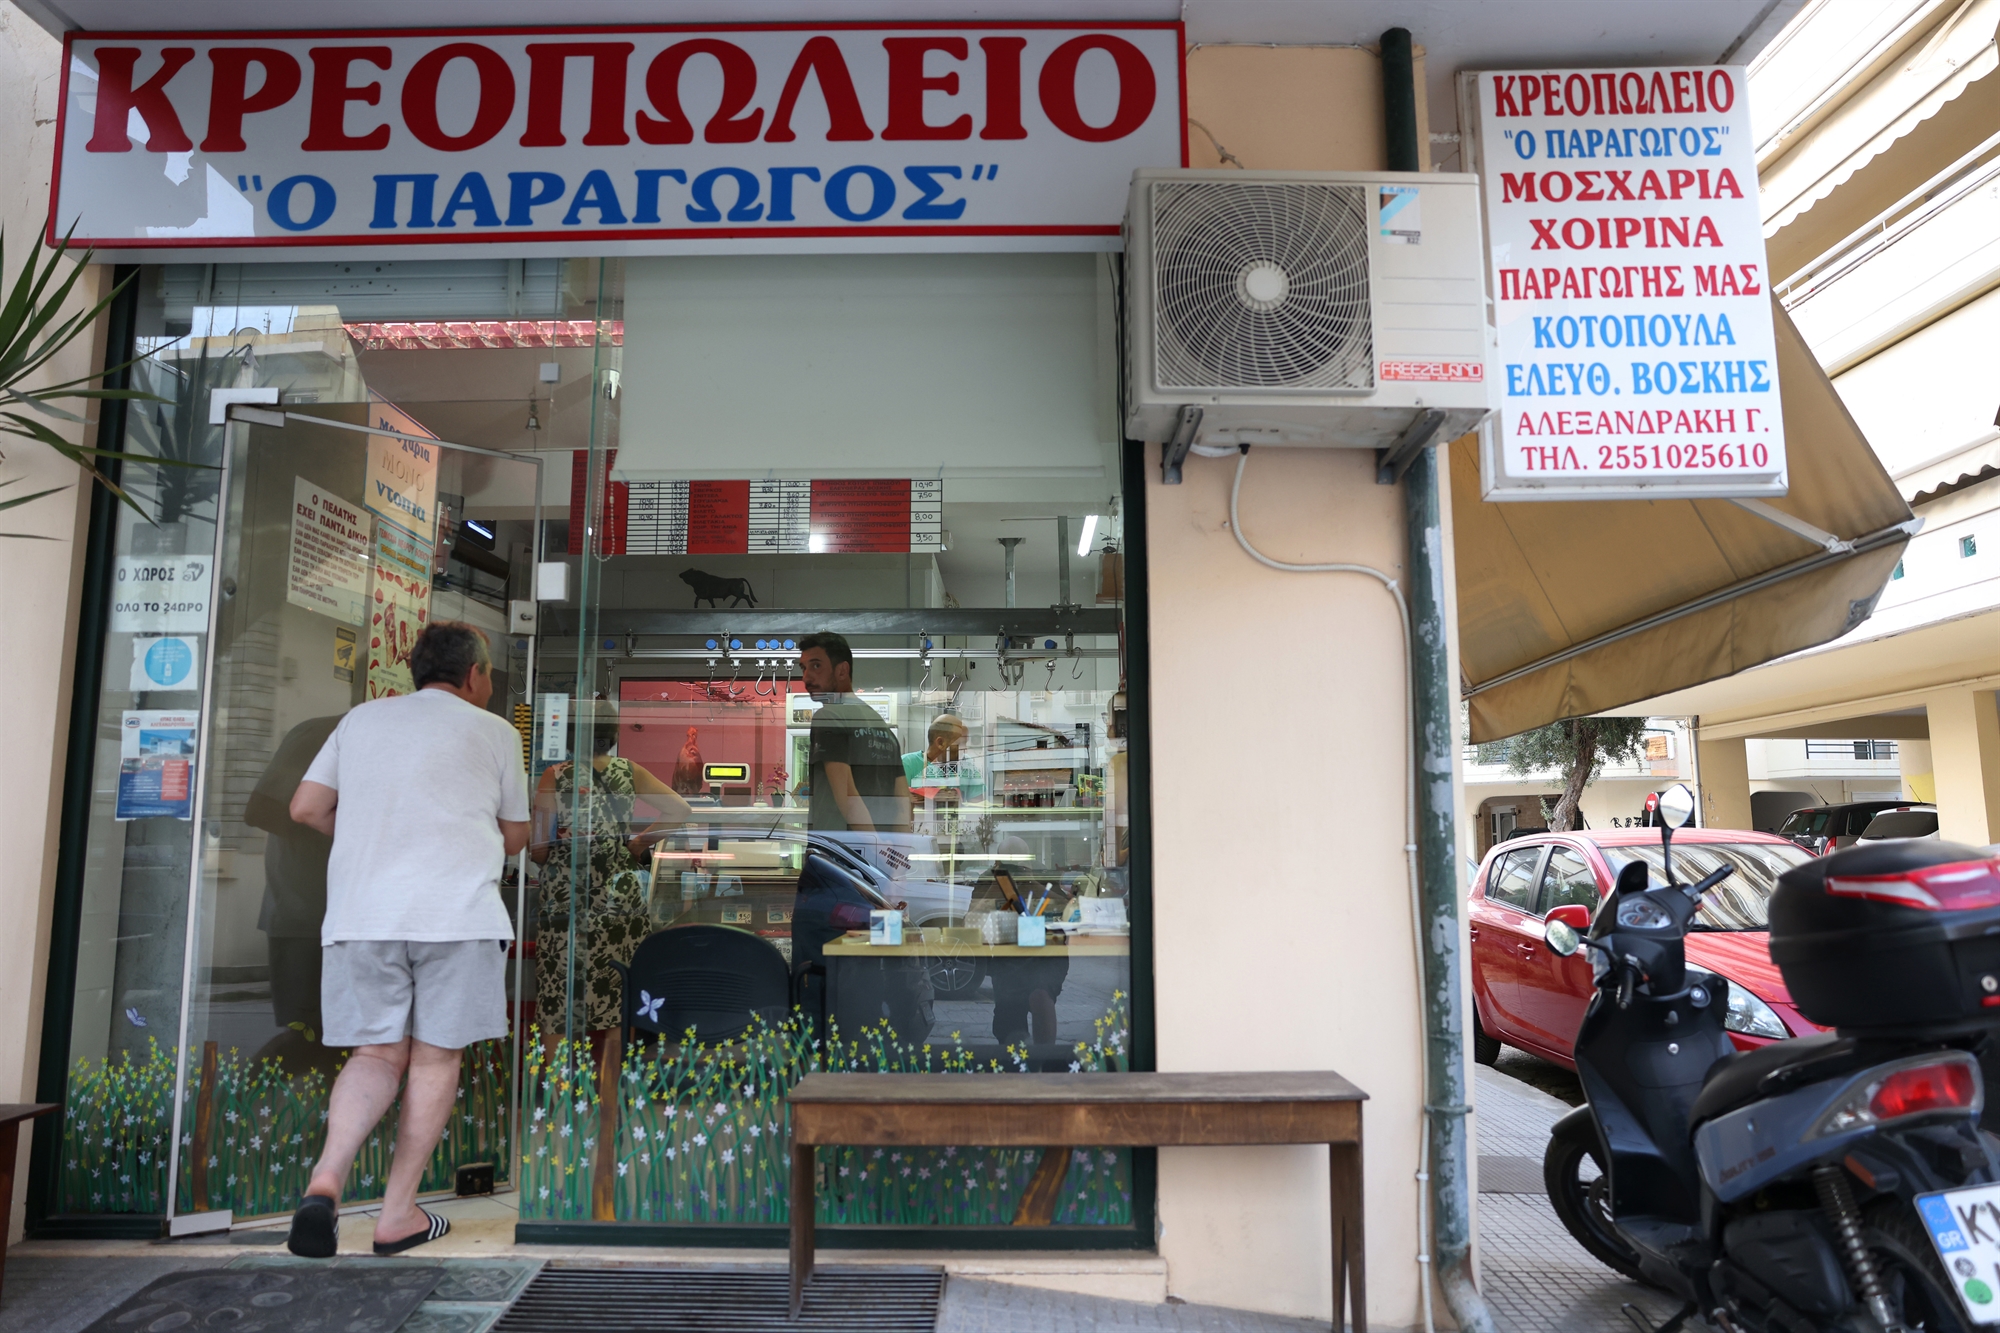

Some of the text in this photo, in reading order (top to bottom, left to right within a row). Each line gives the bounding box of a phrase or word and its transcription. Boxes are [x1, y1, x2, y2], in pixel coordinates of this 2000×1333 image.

[86, 34, 1156, 152] ΚΡΕΟΠΩΛΕΙΟ
[1493, 69, 1734, 118] ΚΡΕΟΠΩΛΕΙΟ
[1500, 168, 1743, 203] ΜΟΣΧΑΡΙΑ
[1529, 216, 1723, 250] ΧΟΙΡΙΝΑ
[1499, 264, 1760, 300] ΠΑΡΑΓΩΓΗΣ ΜΑΣ
[1533, 313, 1735, 349] ΚΟΤΟΠΟΥΛΑ
[1381, 362, 1482, 377] FREEZELAND
[1506, 360, 1771, 397] ΕΛΕΥΘ. ΒΟΣΚΗΣ
[1516, 409, 1769, 436] ΑΛΕΞΑΝΔΡΑΚΗ Γ.
[1520, 442, 1769, 471] ΤΗΛ. 2551025610
[915, 481, 934, 489] 10,40
[297, 503, 368, 546] ΕΧΕΙ ΠΑΝΤΑ ΔΙΚΙΟ
[312, 494, 357, 526] Ο ΠΕΛΑΤΗΣ
[915, 513, 933, 521] 8,00
[916, 534, 934, 543] 9,50
[118, 568, 126, 581] Ο
[133, 567, 175, 581] ΧΩΡΟΣ
[116, 603, 203, 612] ΟΛΟ ΤΟ 24ΩΡΟ
[1936, 1230, 1964, 1249] GR
